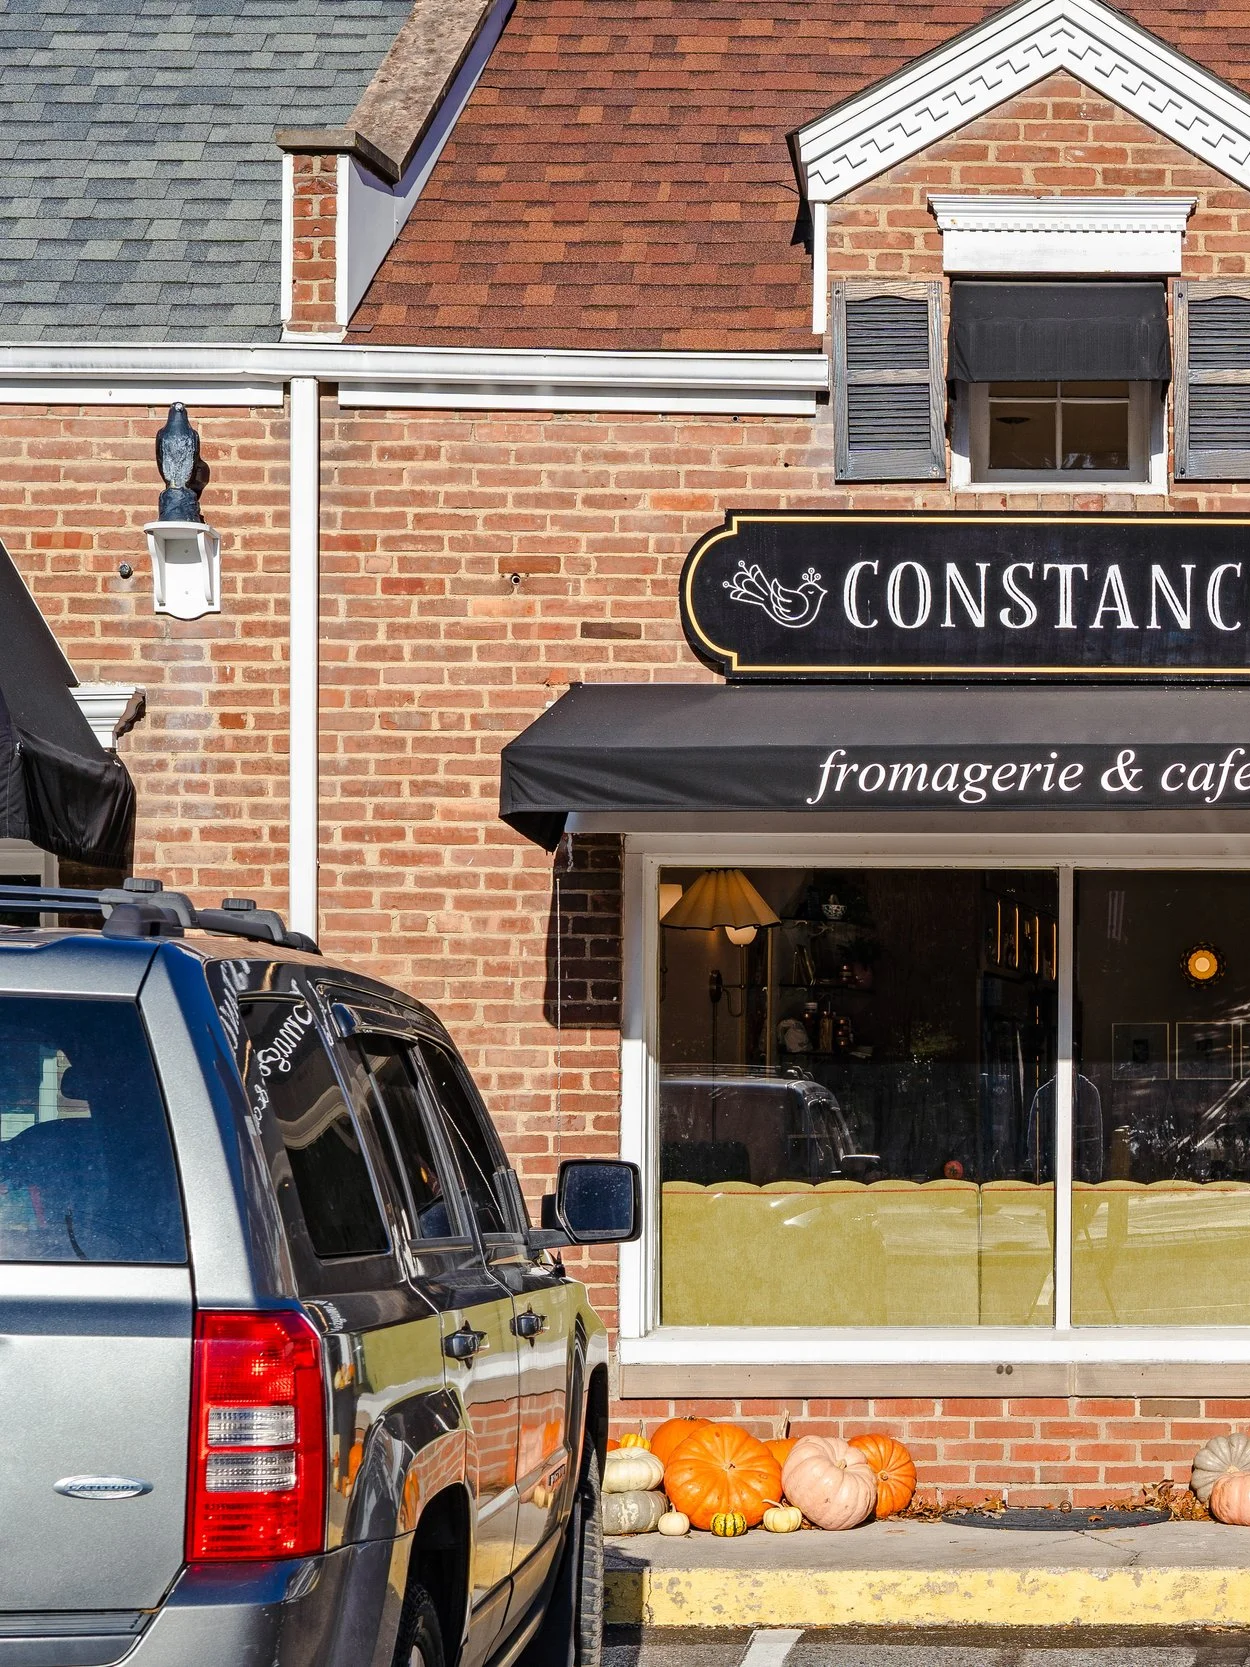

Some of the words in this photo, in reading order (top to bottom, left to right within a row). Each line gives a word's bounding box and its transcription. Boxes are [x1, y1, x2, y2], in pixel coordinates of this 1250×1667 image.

[806, 748, 1083, 805] fromagerie
[1100, 749, 1144, 793] &
[67, 1484, 140, 1492] LATITUDE
